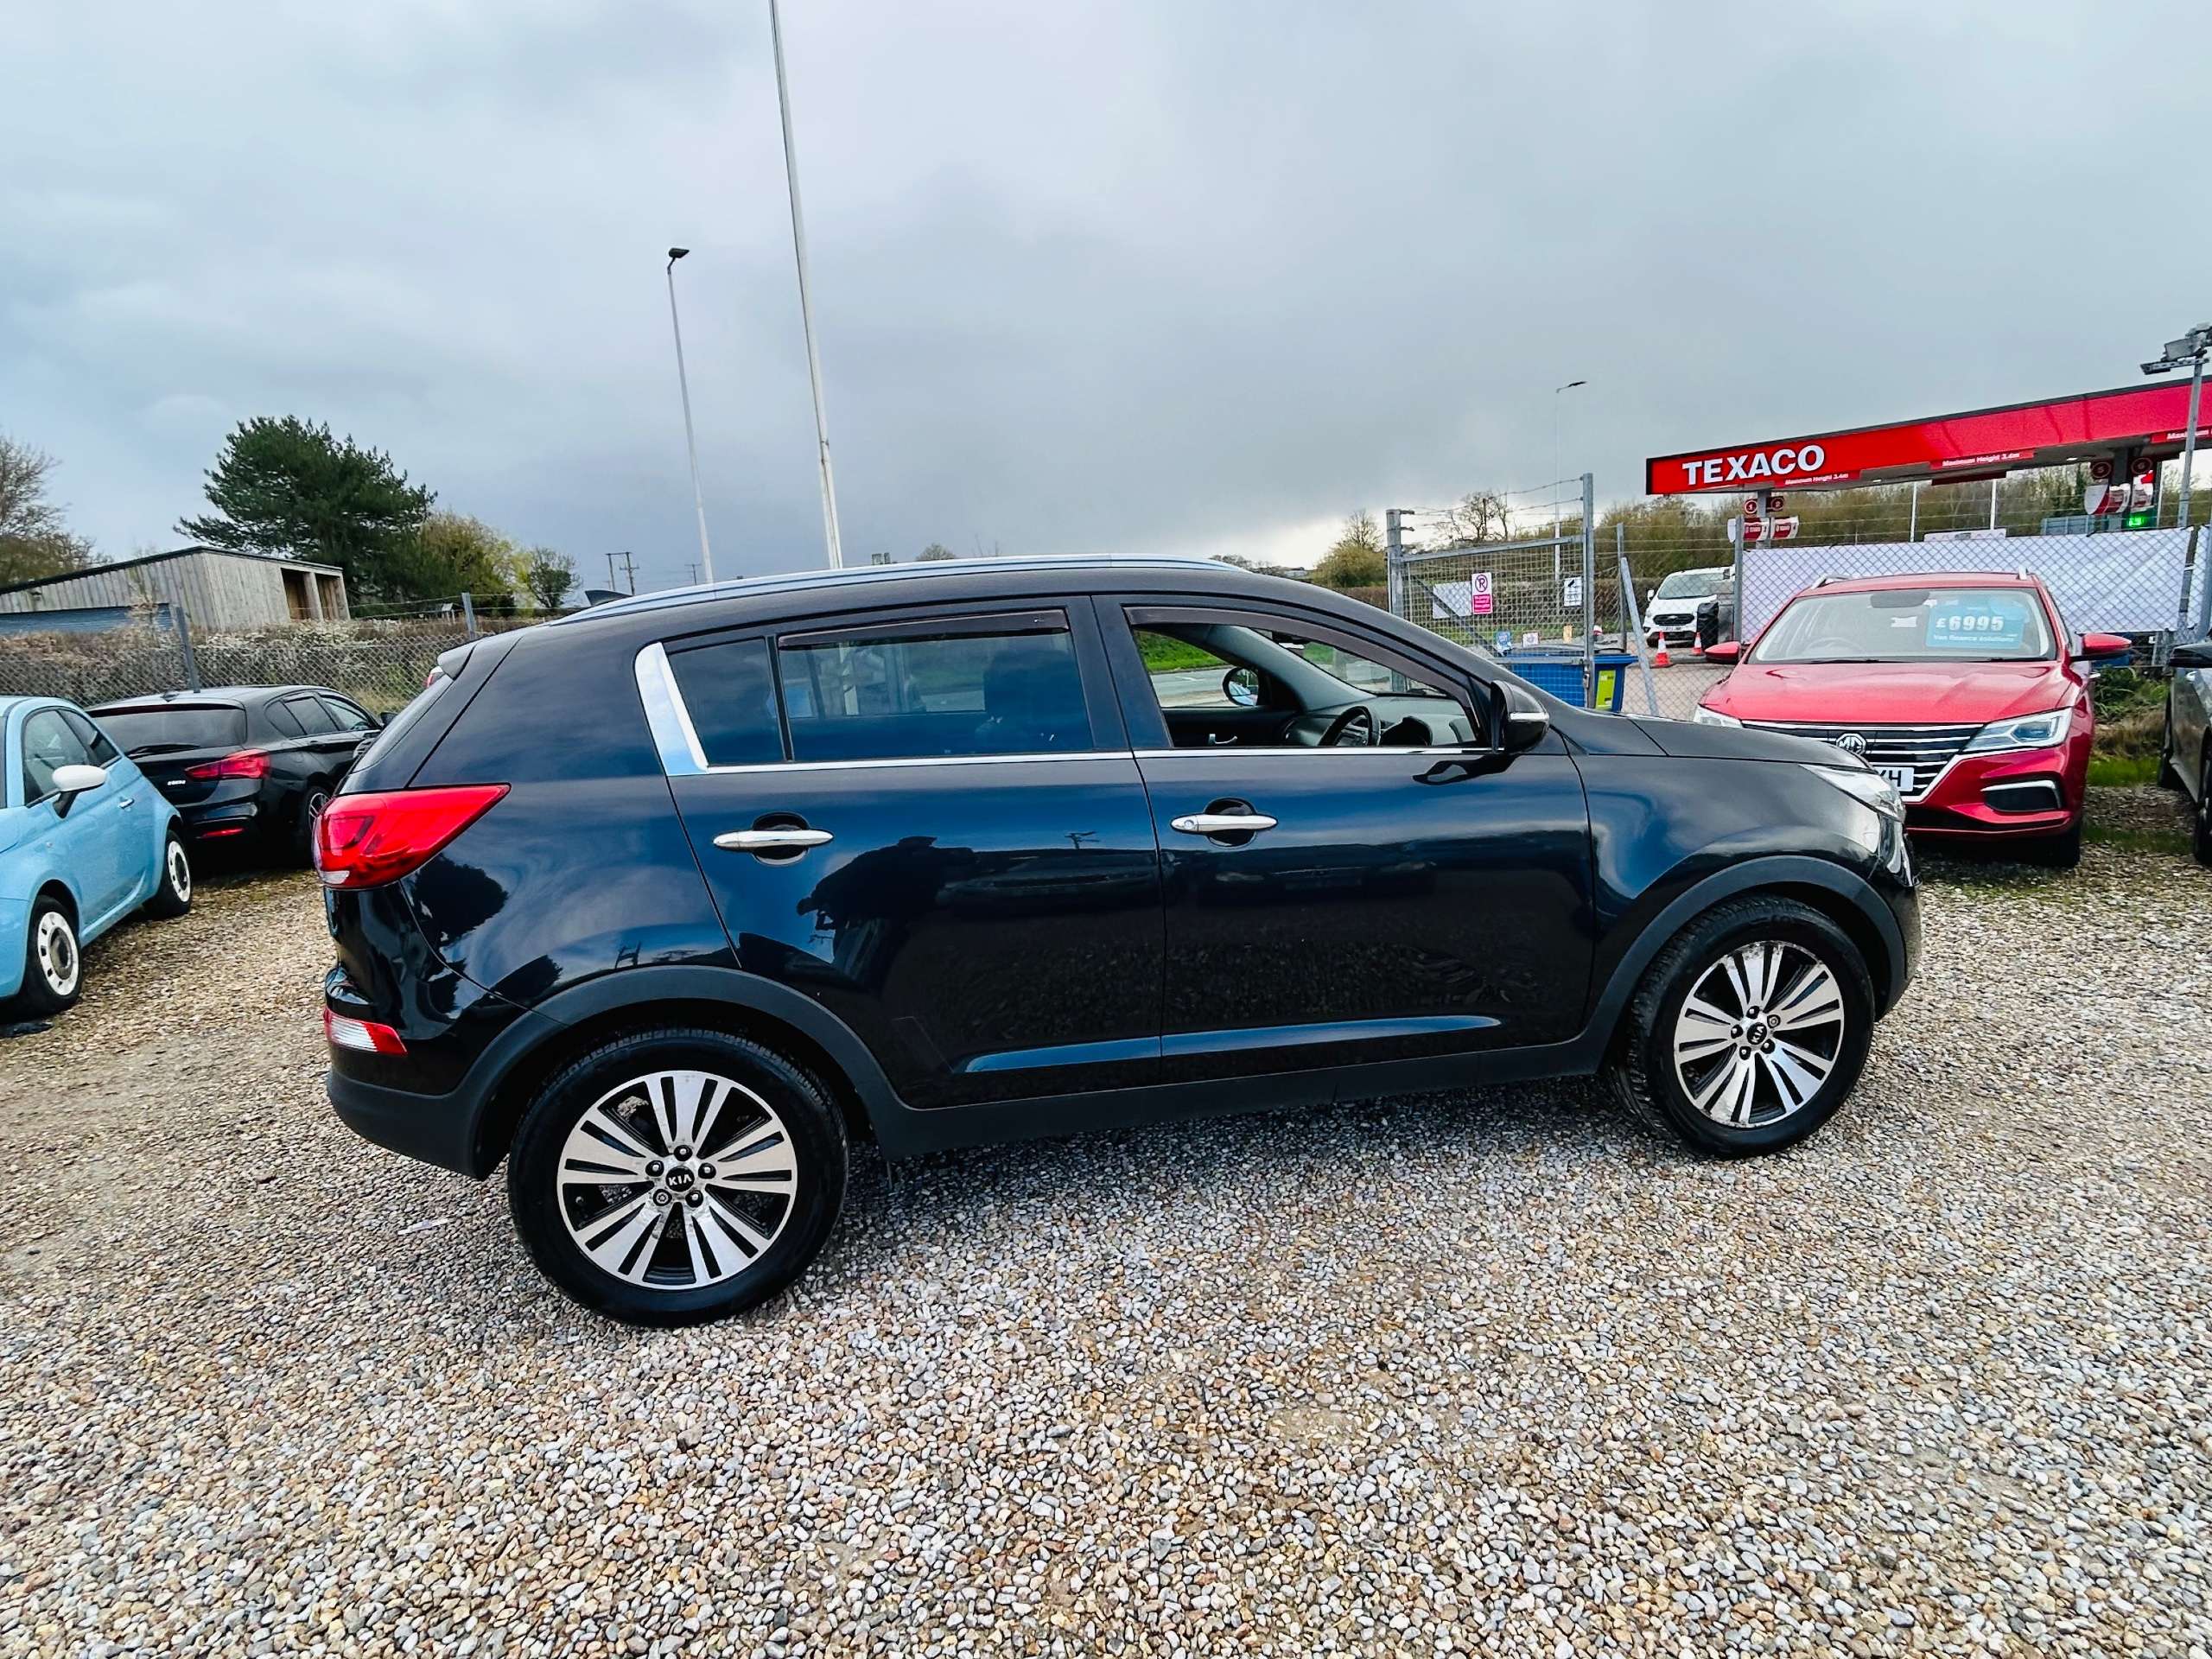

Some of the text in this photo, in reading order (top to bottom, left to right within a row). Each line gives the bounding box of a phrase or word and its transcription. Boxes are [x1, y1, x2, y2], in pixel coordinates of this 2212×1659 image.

[1681, 445, 1825, 486] TEXACO
[1936, 615, 2004, 631] £6995
[668, 1173, 692, 1185] KIA
